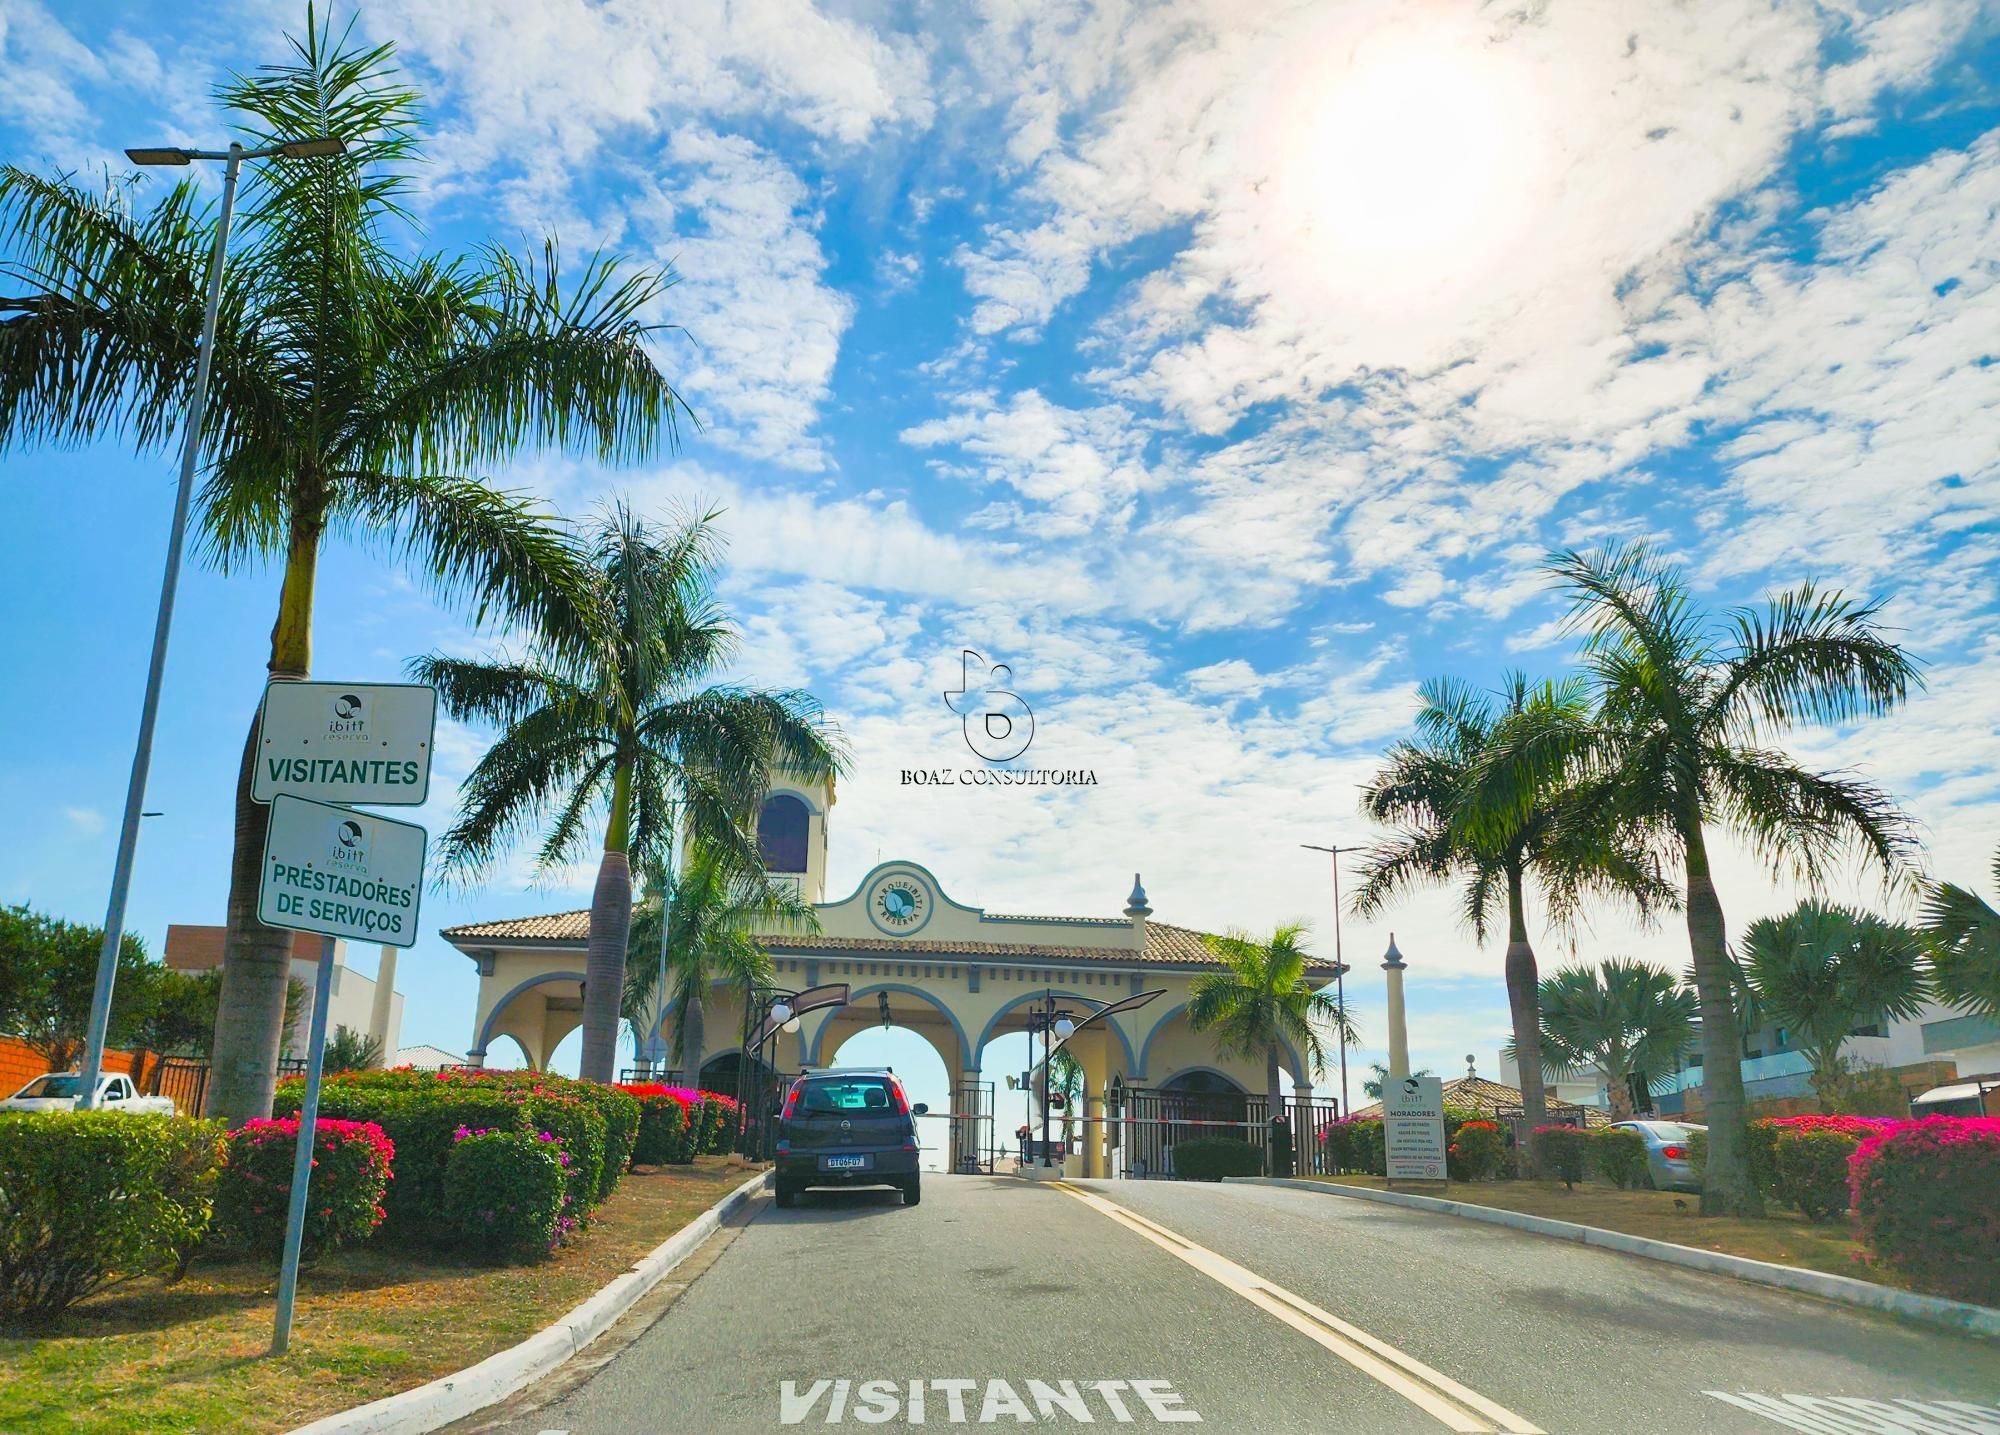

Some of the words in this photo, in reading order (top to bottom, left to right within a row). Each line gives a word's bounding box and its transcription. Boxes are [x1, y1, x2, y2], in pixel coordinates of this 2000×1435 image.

[268, 758, 419, 785] VISITANTES
[273, 863, 411, 908] PRESTADORES
[277, 892, 303, 916] DE
[309, 899, 402, 933] SERVIÇOS
[881, 911, 920, 926] RESERVA
[779, 1379, 1204, 1424] VISITANTE
